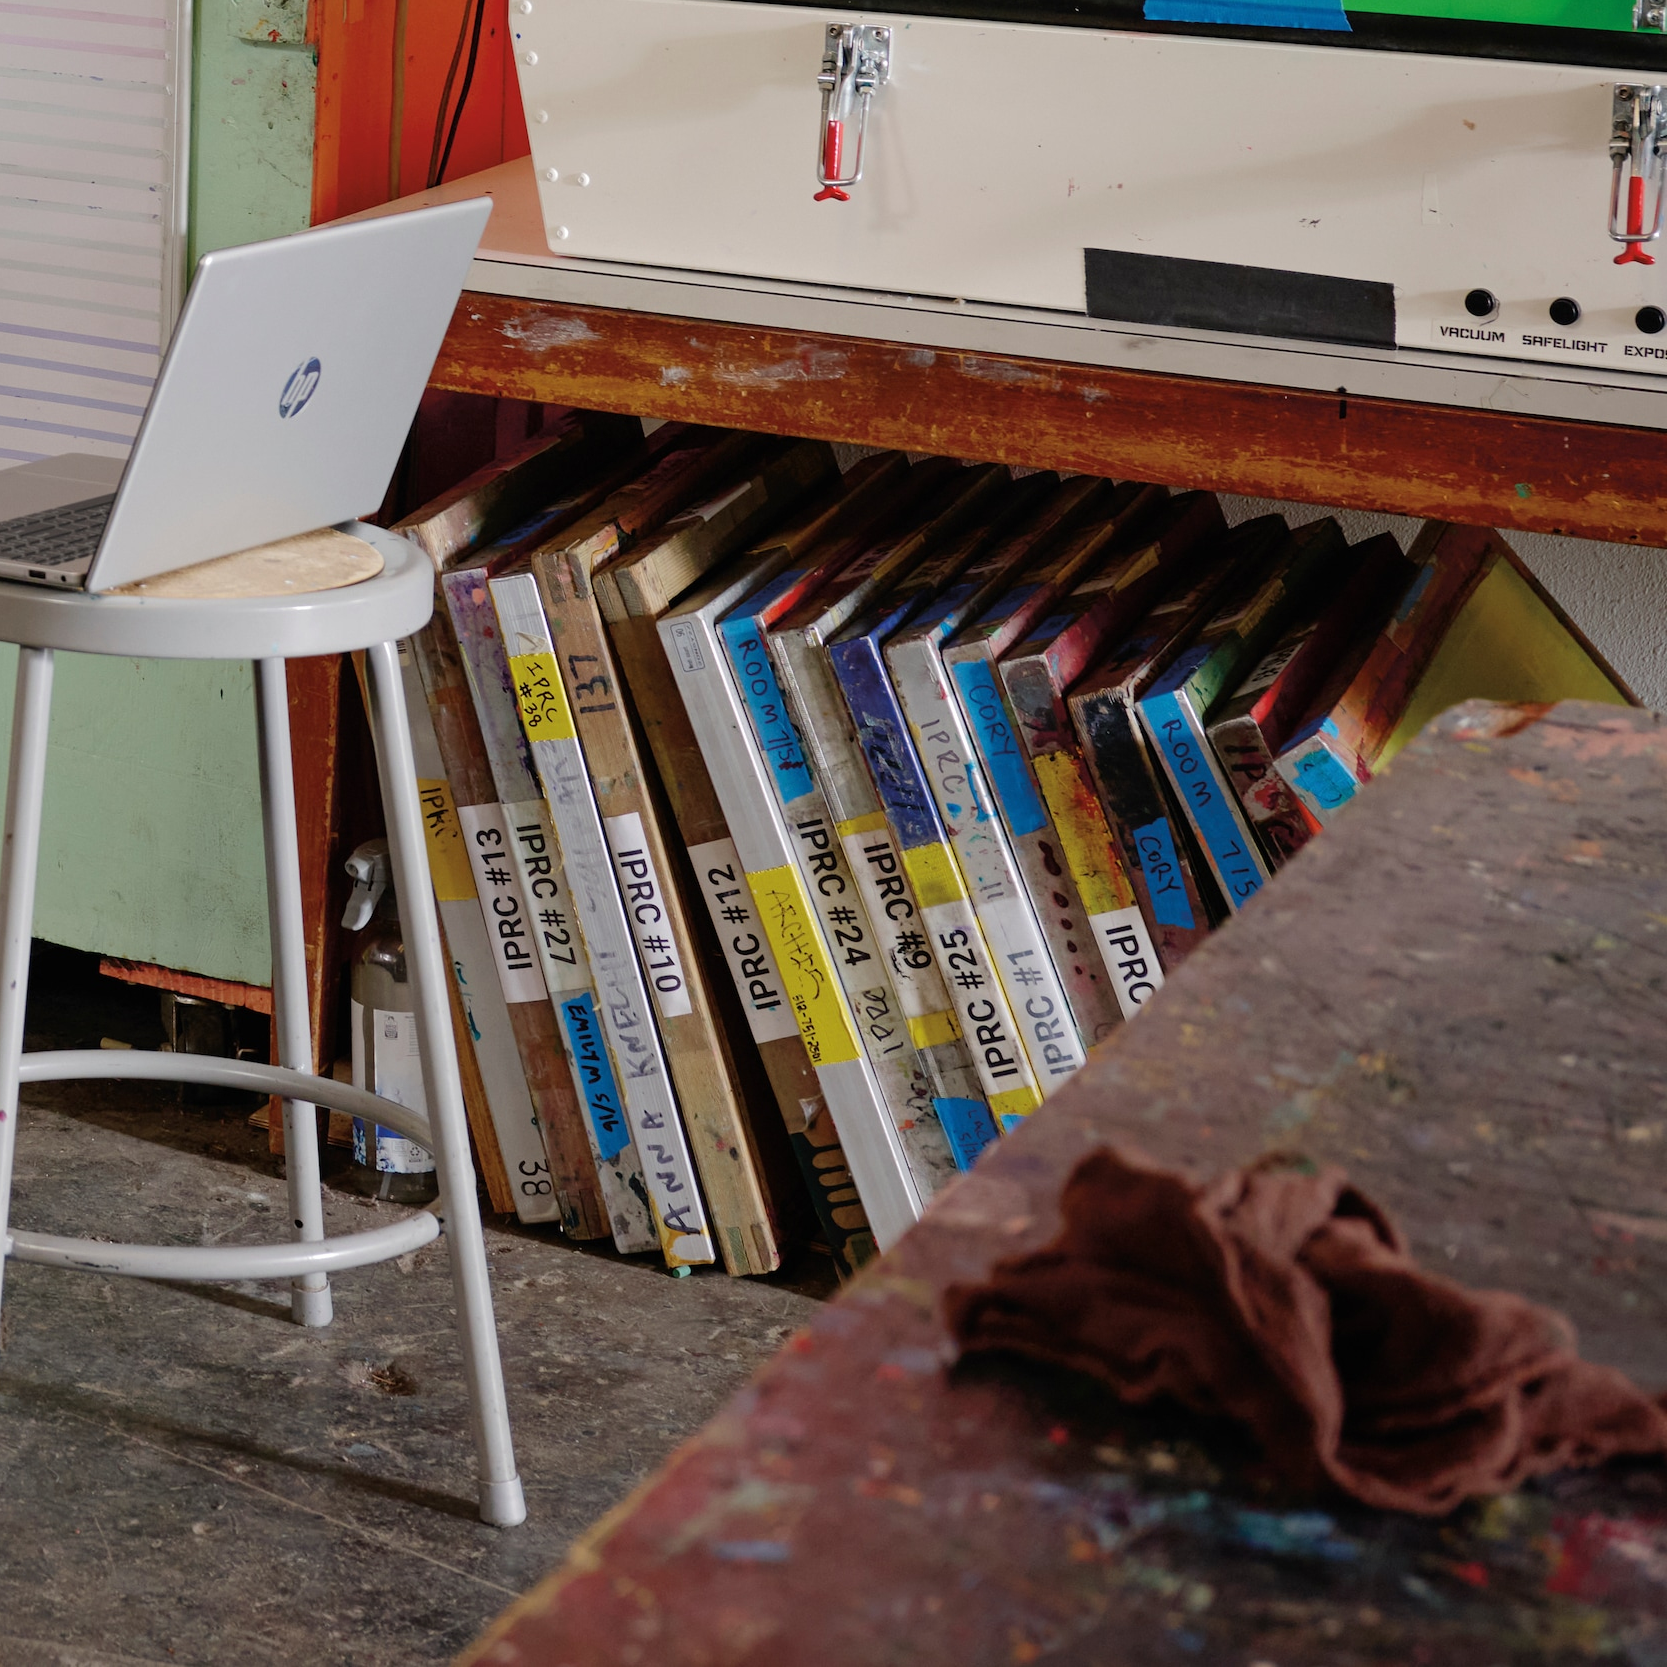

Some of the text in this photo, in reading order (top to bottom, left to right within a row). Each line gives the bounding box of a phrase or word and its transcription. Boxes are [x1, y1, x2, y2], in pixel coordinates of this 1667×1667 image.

[1439, 324, 1609, 355] VACUUM SAFELIGHT
[280, 359, 320, 418] hp
[526, 661, 559, 725] IPRC
[567, 653, 617, 715] 137
[736, 638, 779, 725] ROOM
[968, 684, 1018, 759] CORY
[920, 718, 966, 796] IPRC
[1160, 718, 1213, 809] ROOM
[475, 827, 534, 971] IPRC #13
[516, 822, 578, 966] IPRC #27
[796, 817, 847, 898] IPRC
[827, 905, 873, 968] #24
[862, 841, 933, 970] IPRC #9
[1138, 835, 1182, 897] CORY
[617, 848, 662, 926] IPRC
[641, 935, 682, 995] #10
[707, 862, 783, 1011] IPRC #12
[1104, 923, 1158, 1007] IPRC
[948, 927, 1019, 1080] IPRC #25
[1006, 948, 1075, 1077] IPRC #1
